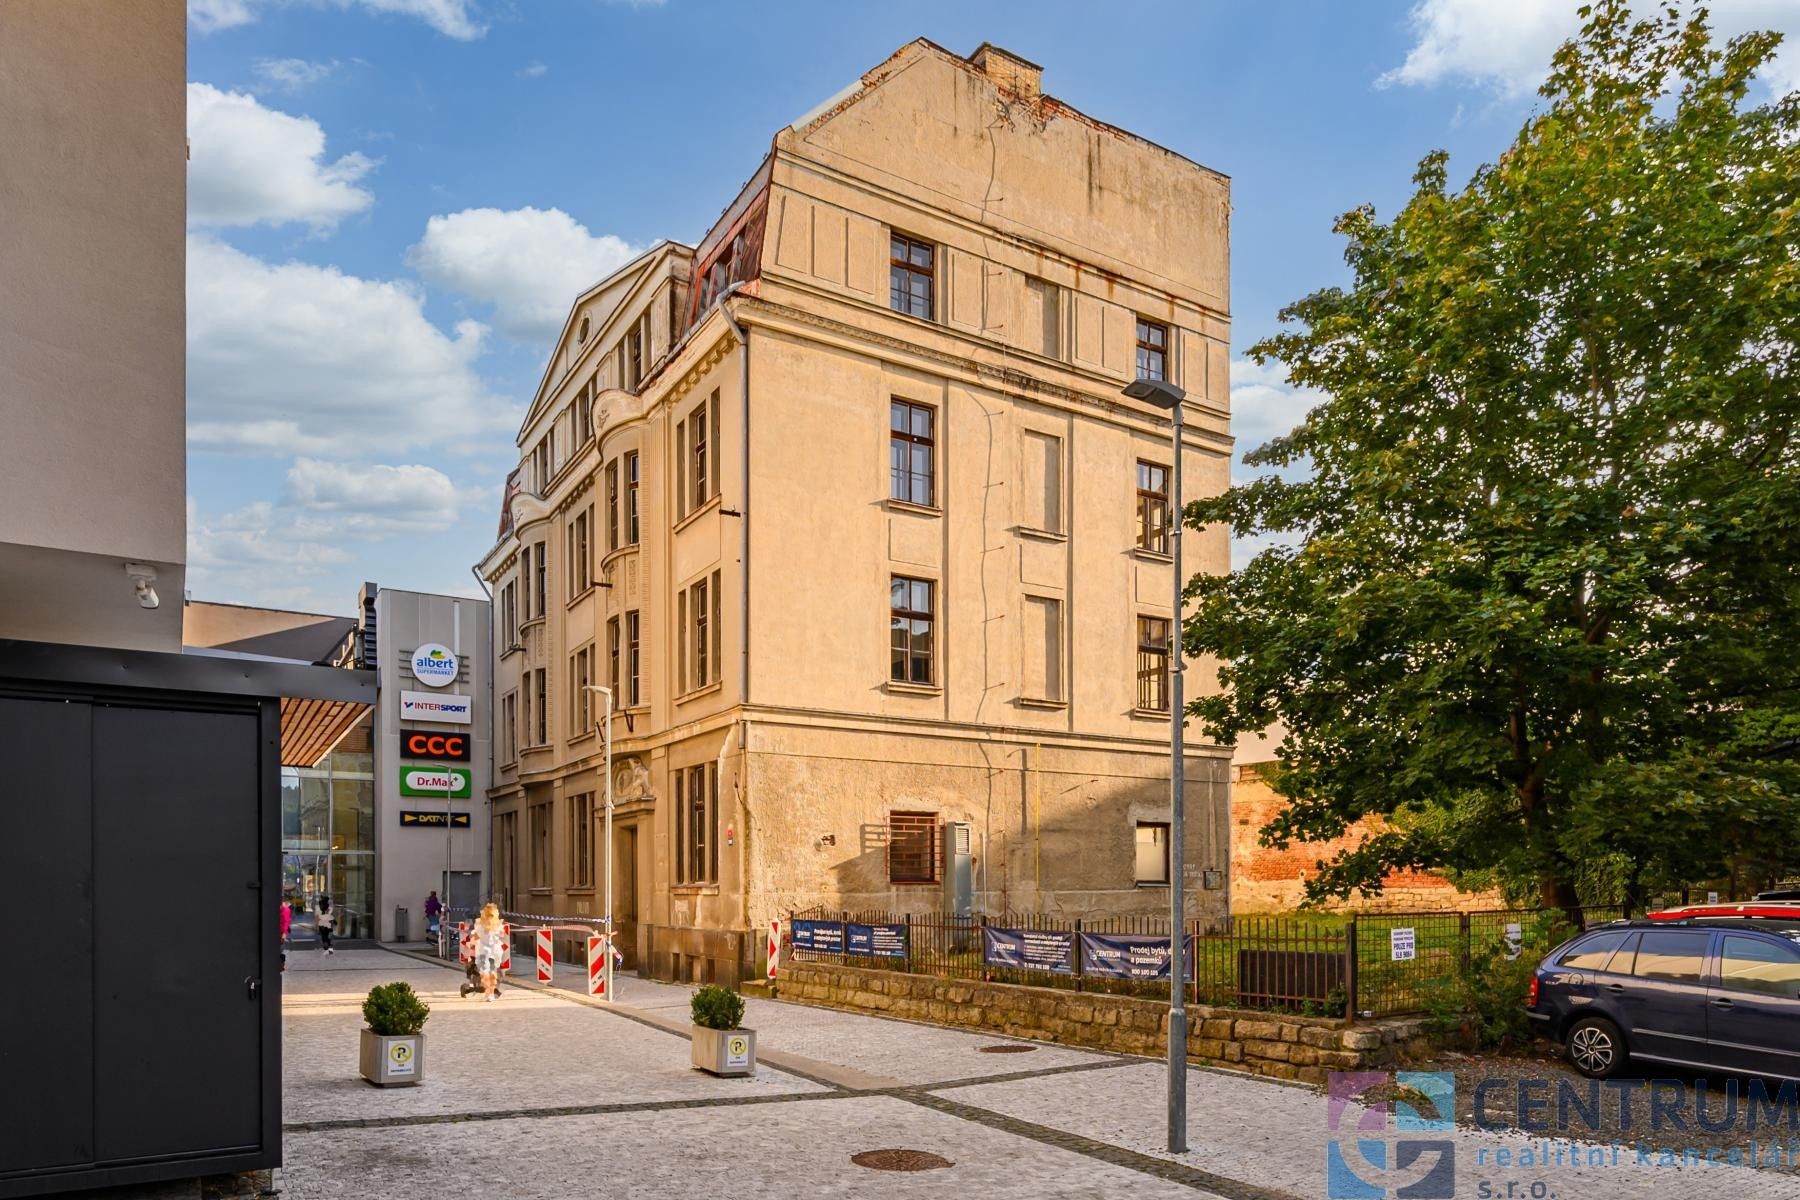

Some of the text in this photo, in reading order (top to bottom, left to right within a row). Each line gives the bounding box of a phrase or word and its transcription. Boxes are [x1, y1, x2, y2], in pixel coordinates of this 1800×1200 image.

[416, 657, 454, 669] albert
[414, 702, 467, 712] INTERSPORT
[409, 735, 463, 756] CCC
[417, 777, 454, 787] Dr.Max
[1096, 950, 1121, 958] CENTRUM
[1130, 946, 1150, 956] Prodej
